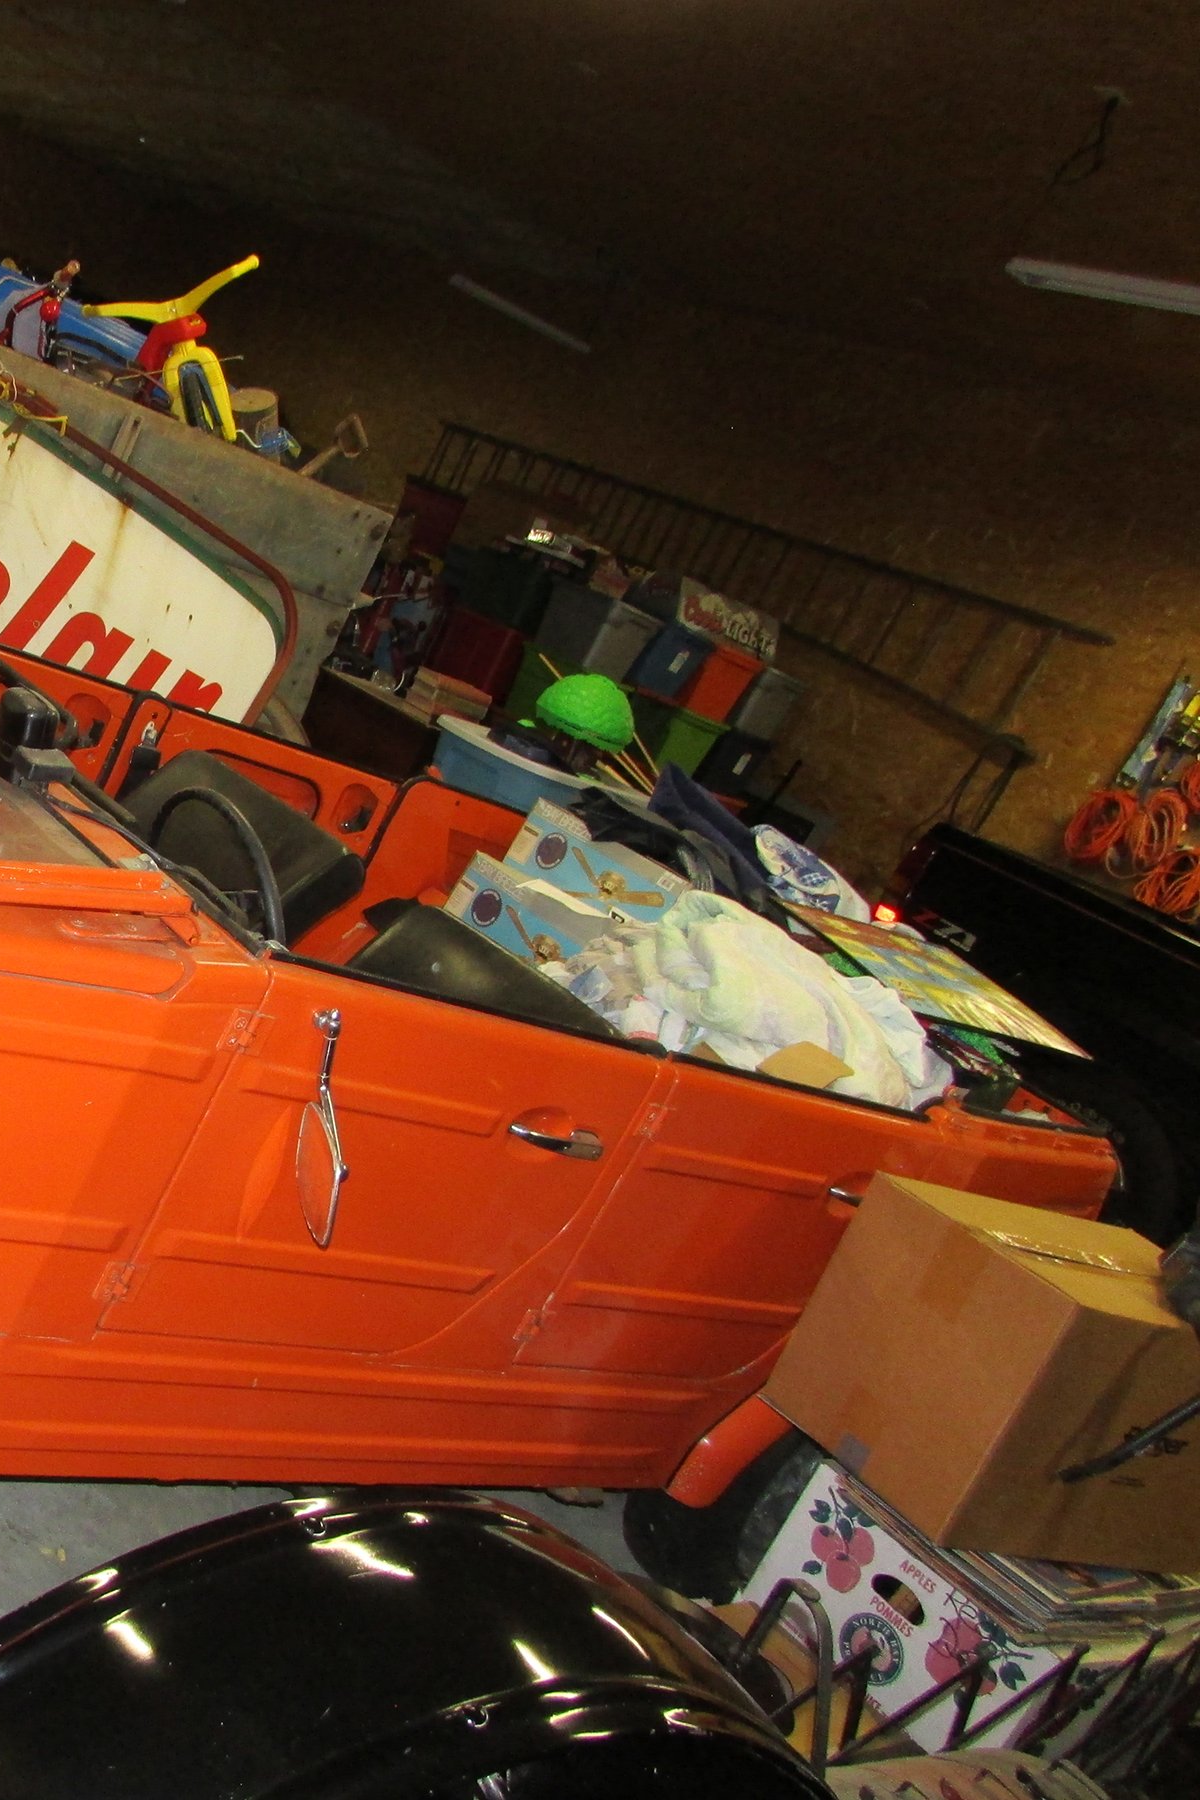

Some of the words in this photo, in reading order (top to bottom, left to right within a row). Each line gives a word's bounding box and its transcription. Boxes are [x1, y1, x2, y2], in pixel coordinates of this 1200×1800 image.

[912, 908, 976, 953] Z71
[899, 1559, 937, 1594] APPLES
[869, 1595, 914, 1638] POMMES
